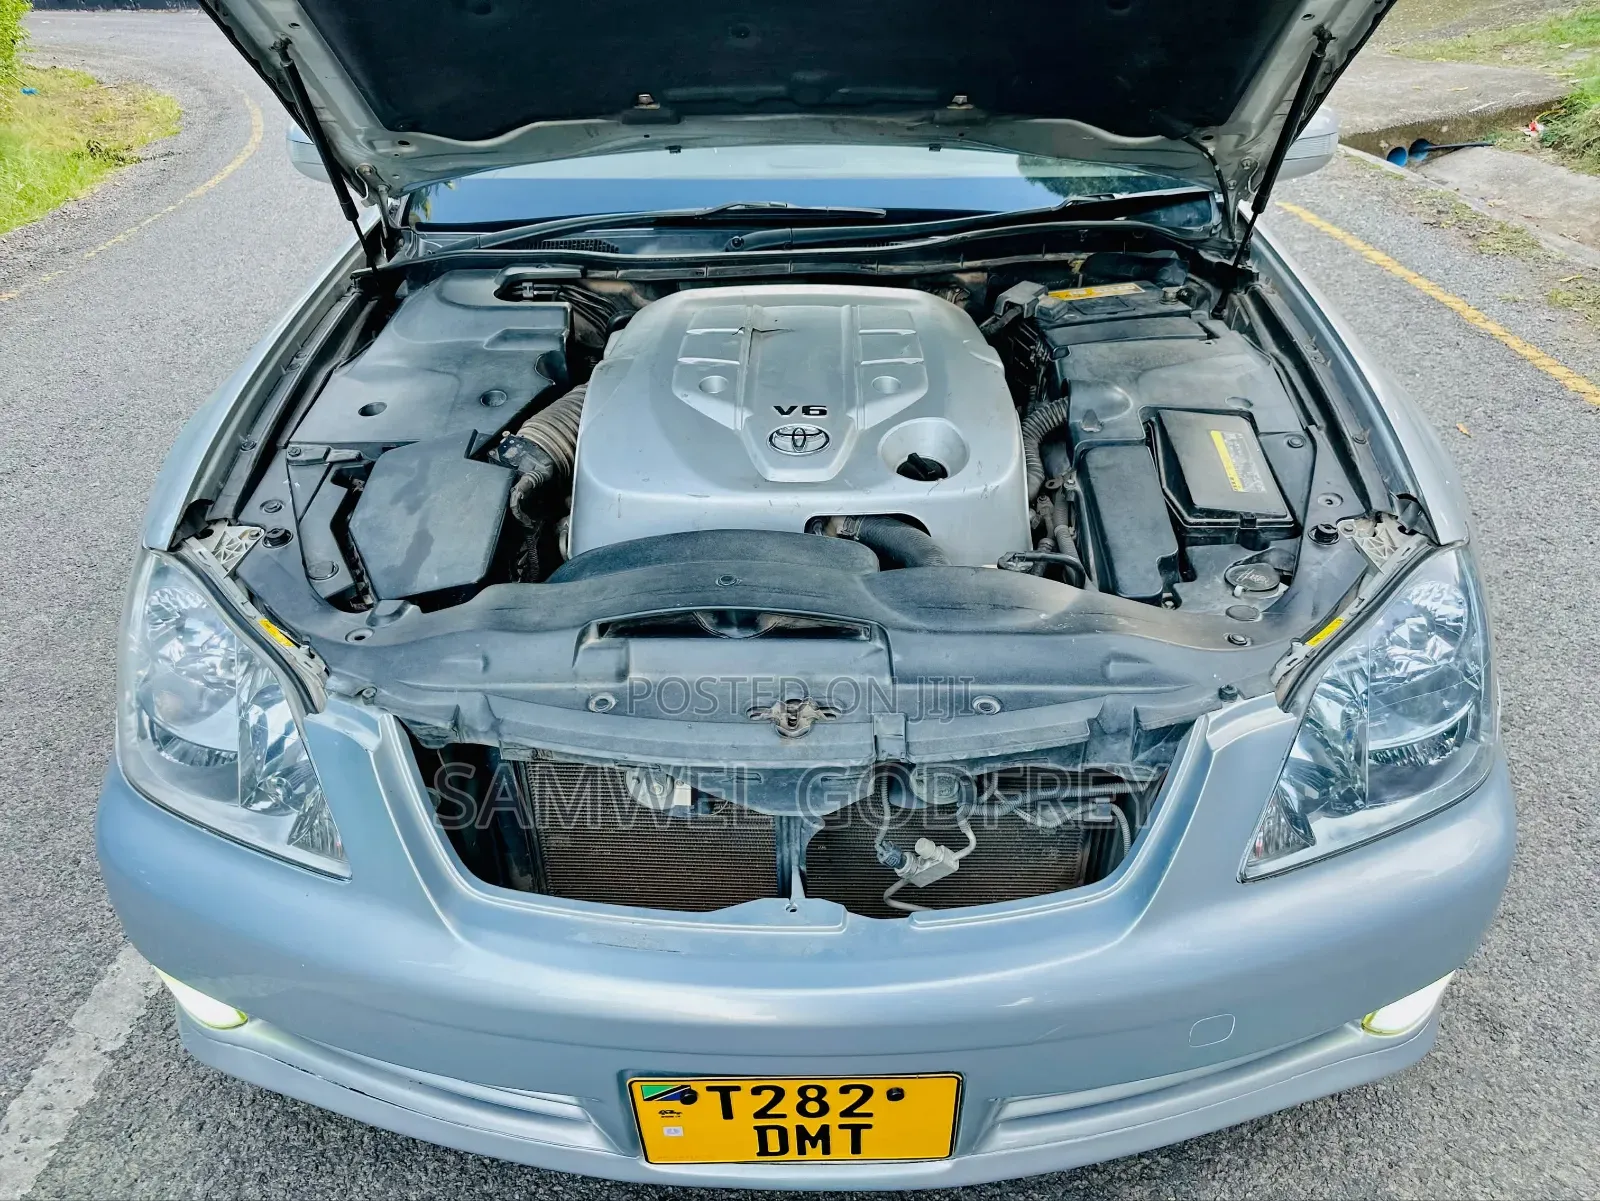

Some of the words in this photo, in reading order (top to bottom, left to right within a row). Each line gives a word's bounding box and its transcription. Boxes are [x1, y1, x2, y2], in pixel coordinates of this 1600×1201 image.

[773, 405, 828, 416] V6
[706, 1084, 874, 1120] T282
[753, 1123, 873, 1157] DMT
